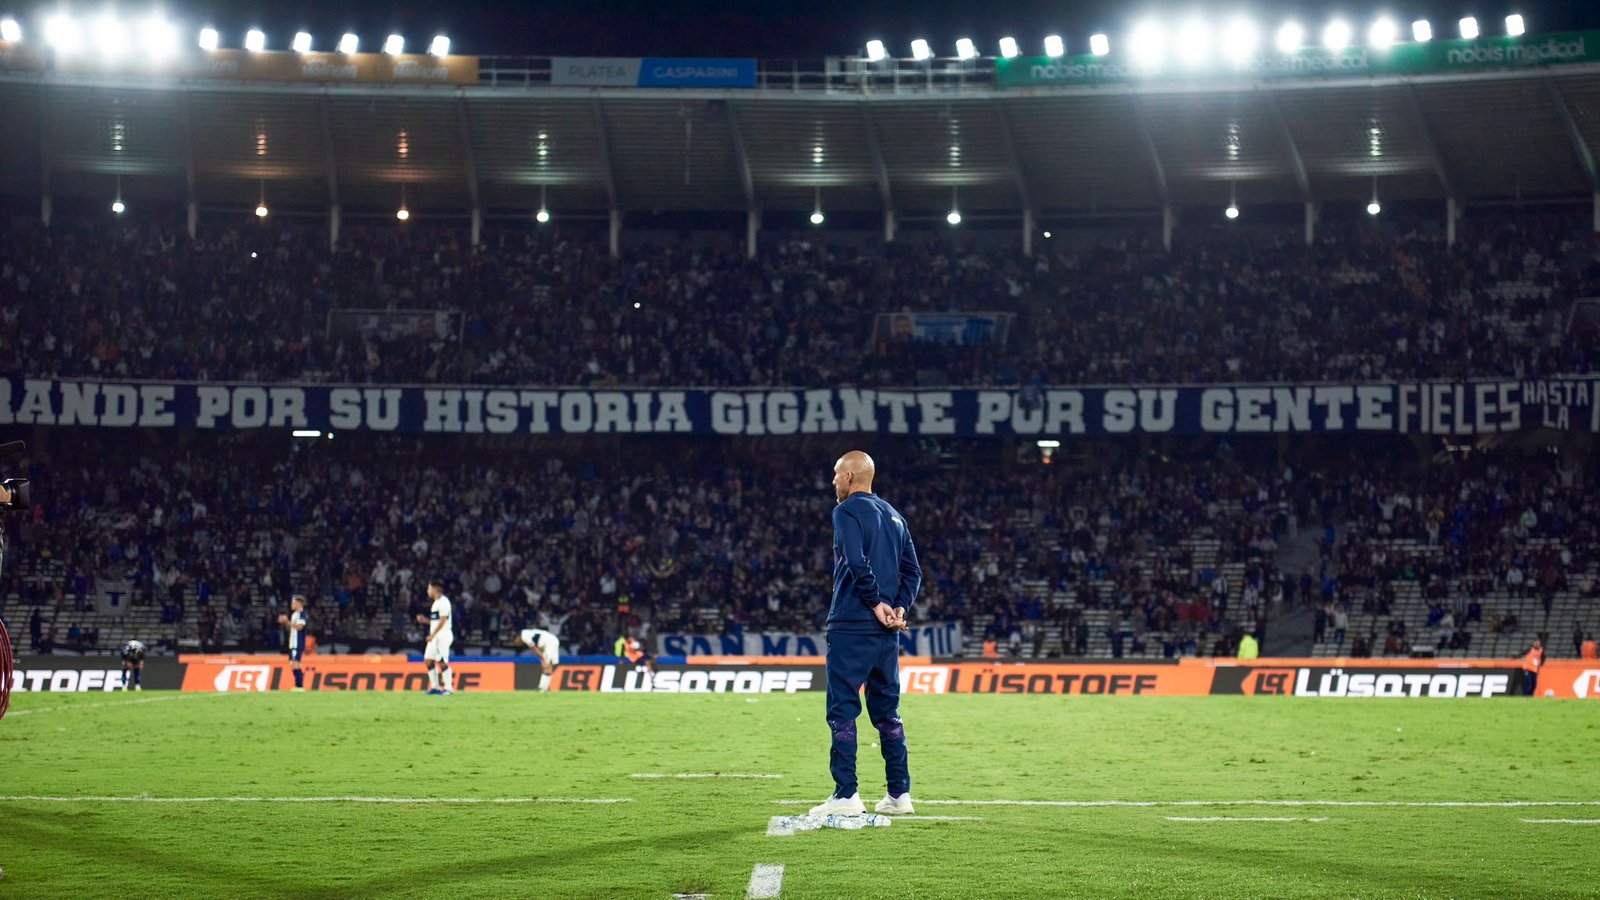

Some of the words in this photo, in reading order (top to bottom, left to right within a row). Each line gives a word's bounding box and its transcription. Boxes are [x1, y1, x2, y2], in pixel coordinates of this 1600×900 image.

[568, 65, 628, 79] PLATEA
[197, 386, 307, 429] POR
[330, 388, 401, 431] SU
[424, 389, 692, 435] HISTORIA
[707, 388, 955, 435] GIGANTE
[976, 388, 1084, 434] POR
[1103, 389, 1177, 433] SU
[1200, 387, 1394, 433] GENTE
[1398, 382, 1521, 435] FIELES
[1523, 380, 1588, 406] HASTA
[1542, 404, 1570, 430] LA
